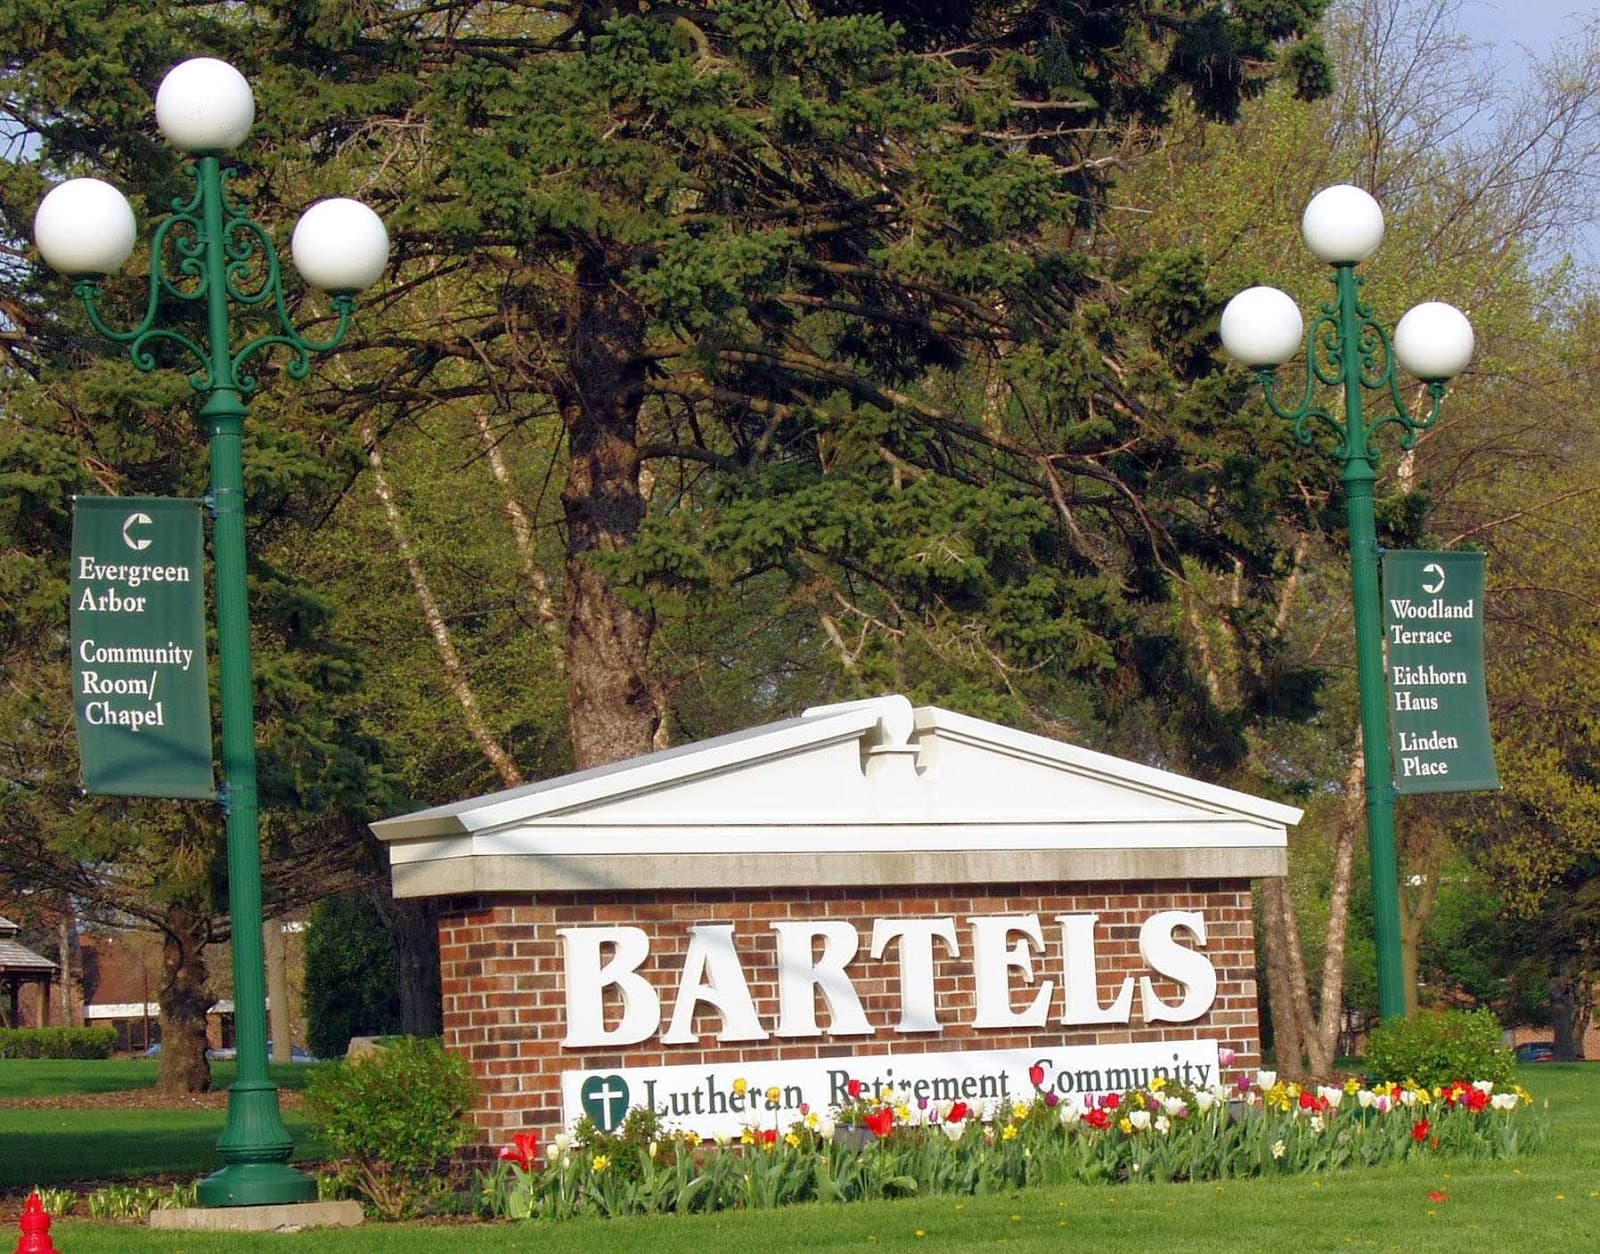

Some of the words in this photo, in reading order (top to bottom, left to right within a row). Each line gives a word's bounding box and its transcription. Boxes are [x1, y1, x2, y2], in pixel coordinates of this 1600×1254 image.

[78, 556, 190, 586] Evergreen
[78, 587, 146, 612] Arbor
[1390, 599, 1474, 619] Woodland
[1391, 625, 1452, 644] Terrace
[79, 639, 193, 671] Community
[80, 670, 157, 700] Room/
[1392, 665, 1467, 686] Eichhorn
[1395, 691, 1439, 711] Haus
[84, 701, 165, 732] Chapel
[1399, 730, 1459, 751] Linden
[1402, 757, 1449, 777] Place
[555, 910, 1218, 1048] BARTELS
